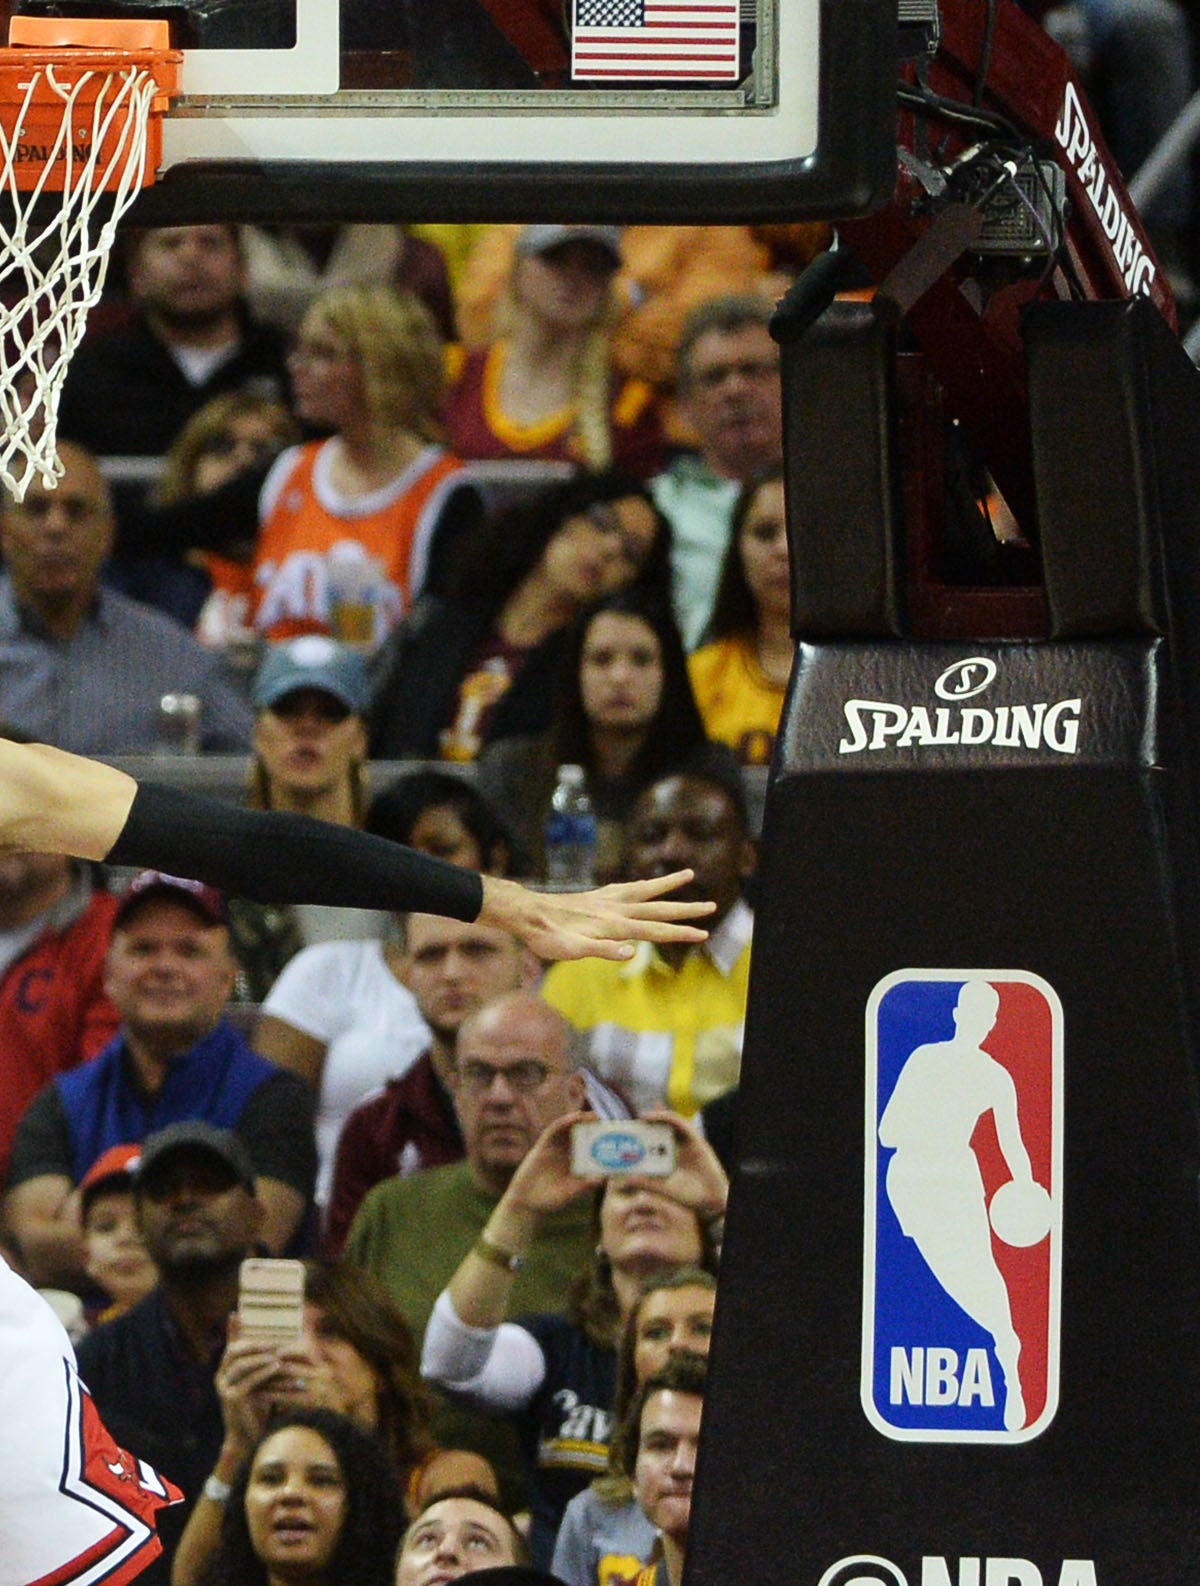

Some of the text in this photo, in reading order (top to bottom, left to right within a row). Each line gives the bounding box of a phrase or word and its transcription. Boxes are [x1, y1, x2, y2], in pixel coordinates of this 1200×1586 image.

[6, 141, 101, 165] PALDN
[1054, 81, 1156, 297] SPALDING
[838, 698, 1082, 754] SPALDING
[889, 1346, 995, 1407] NBA
